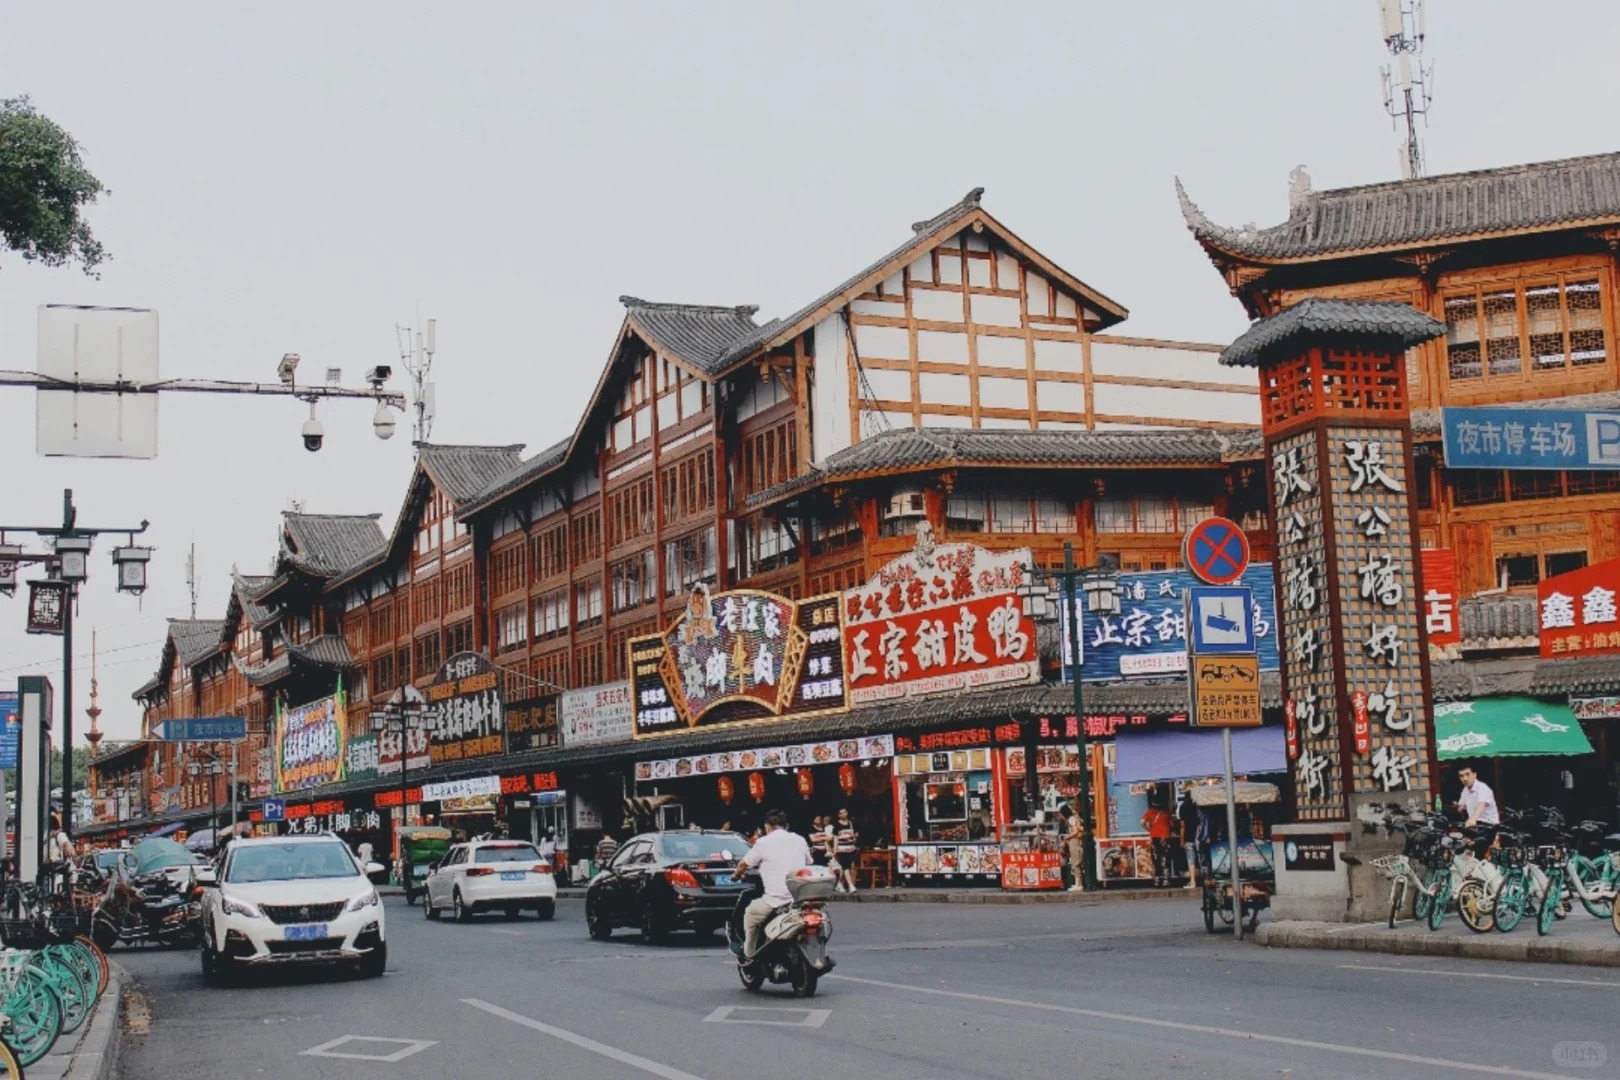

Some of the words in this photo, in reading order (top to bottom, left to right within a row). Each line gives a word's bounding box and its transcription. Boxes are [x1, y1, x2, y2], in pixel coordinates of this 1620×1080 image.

[1456, 420, 1576, 457] 夜市停车场
[1126, 579, 1177, 600] 潘氏
[1541, 585, 1618, 630] 鑫鑫
[851, 596, 1029, 683] 正宗甜皮鸭
[1091, 605, 1270, 648] 正宗甜
[265, 803, 275, 817] P
[287, 811, 380, 834] 兄弟脚肉
